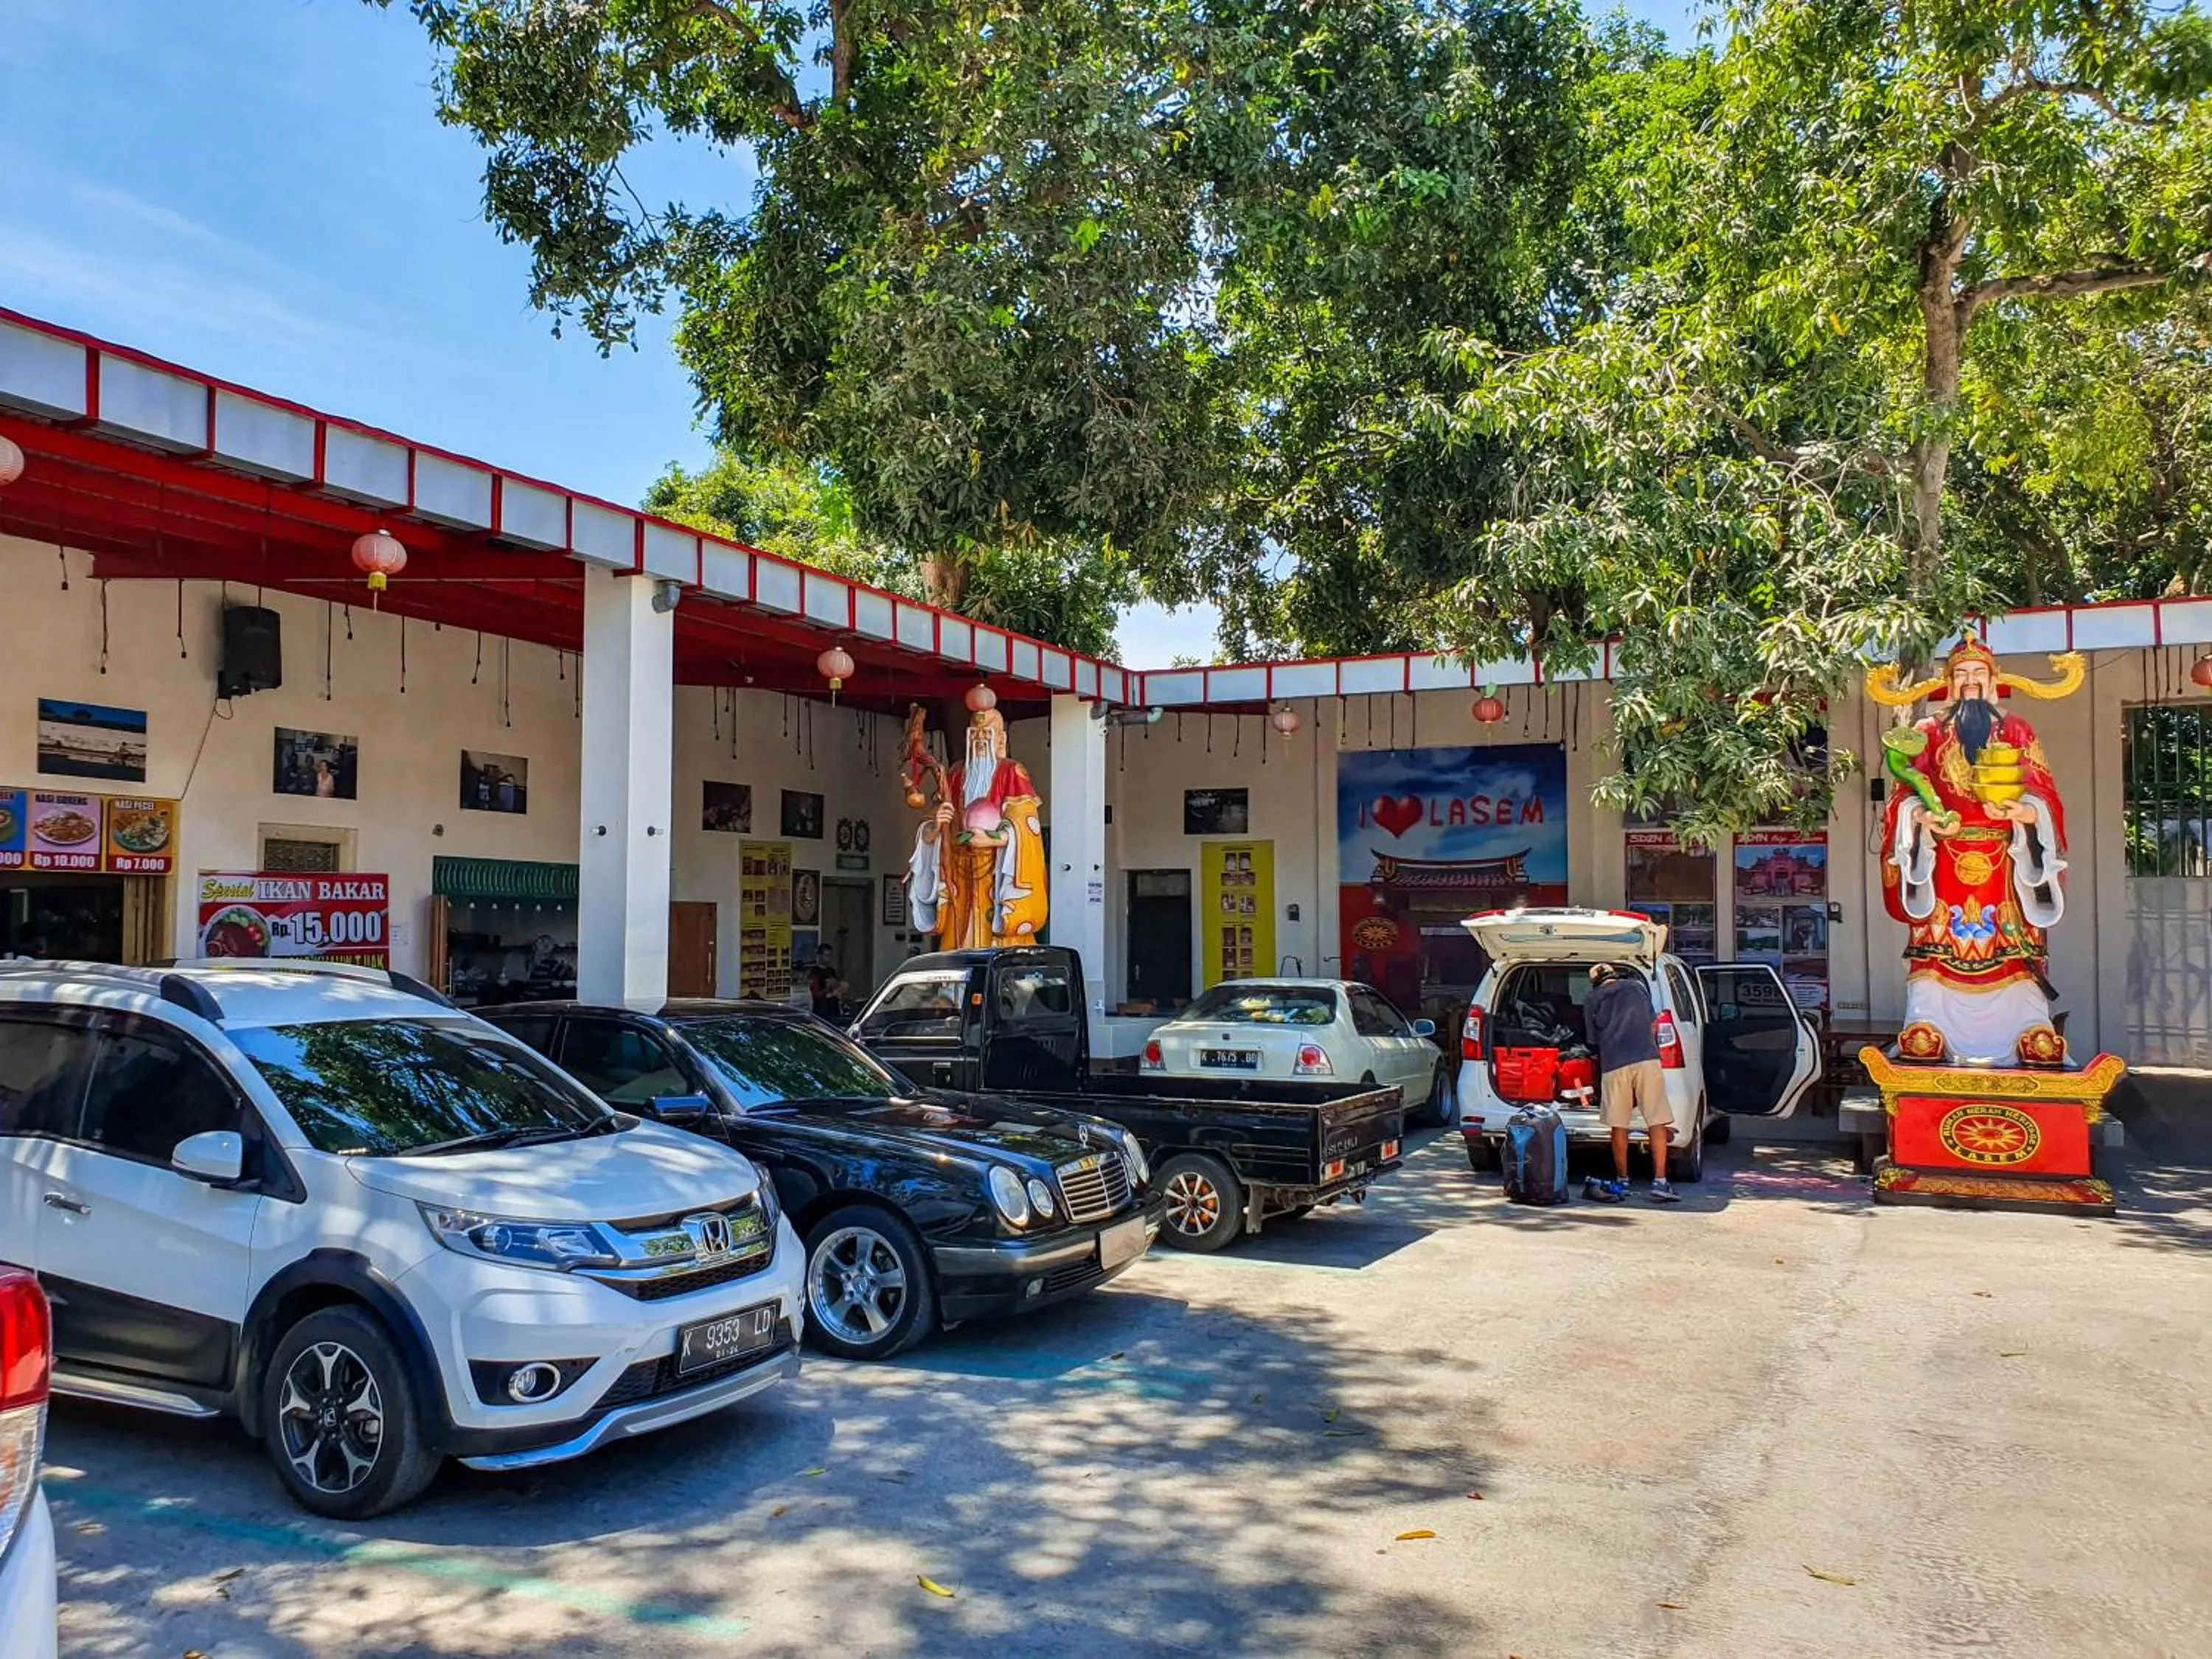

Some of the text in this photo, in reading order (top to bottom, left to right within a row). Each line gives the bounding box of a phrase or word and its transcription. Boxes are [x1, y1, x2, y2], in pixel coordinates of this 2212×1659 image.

[1359, 794, 1543, 830] I LASEM
[34, 855, 95, 868] Rp 10.000
[116, 858, 165, 870] Rp 7.000
[259, 880, 311, 900] IKAN
[318, 881, 386, 900] BAKAR
[292, 911, 382, 945] 15.000
[1954, 1146, 2028, 1163] LASEM
[683, 1309, 771, 1357] K 9353 LD
